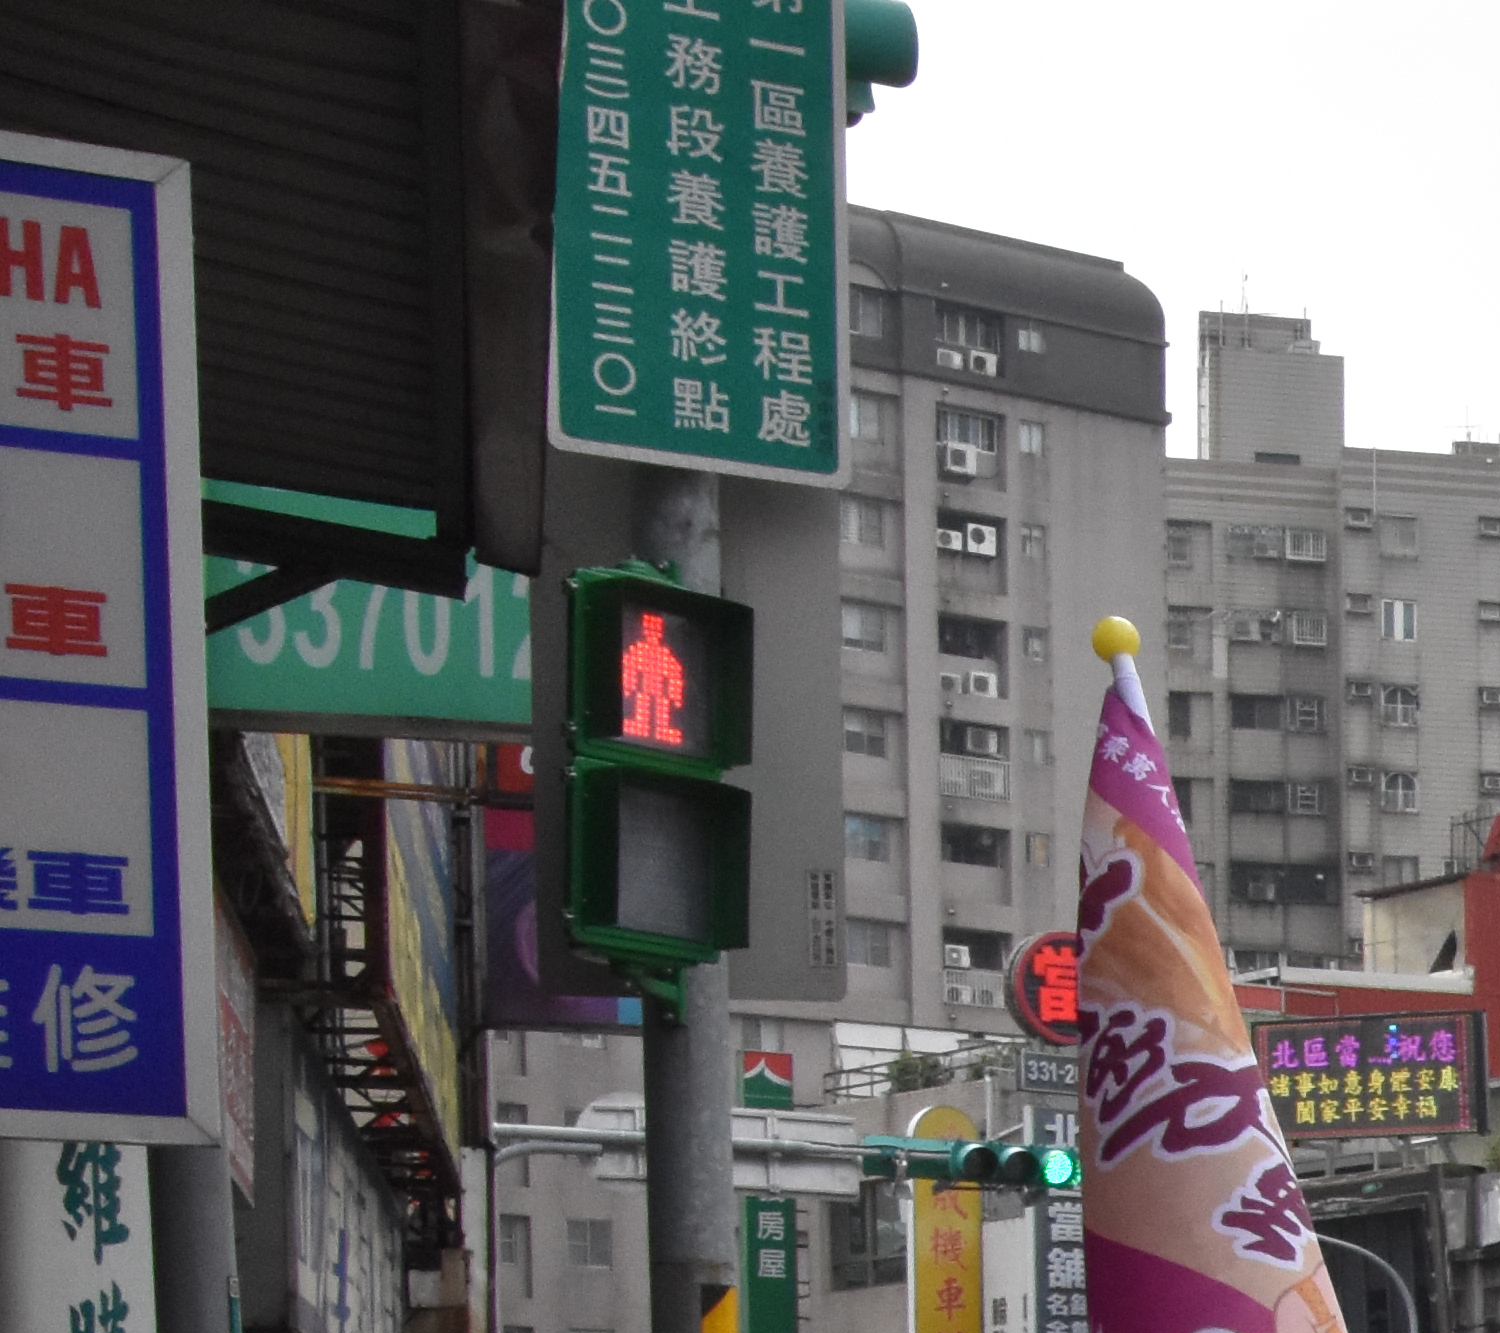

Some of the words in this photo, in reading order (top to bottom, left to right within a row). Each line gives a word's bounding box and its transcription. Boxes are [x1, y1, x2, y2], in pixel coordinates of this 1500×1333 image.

[750, 0, 813, 447] 一區養護工程處
[15, 332, 113, 411] 車
[5, 582, 107, 659] 車
[0, 962, 139, 1074] 修
[757, 1197, 787, 1280] 房屋
